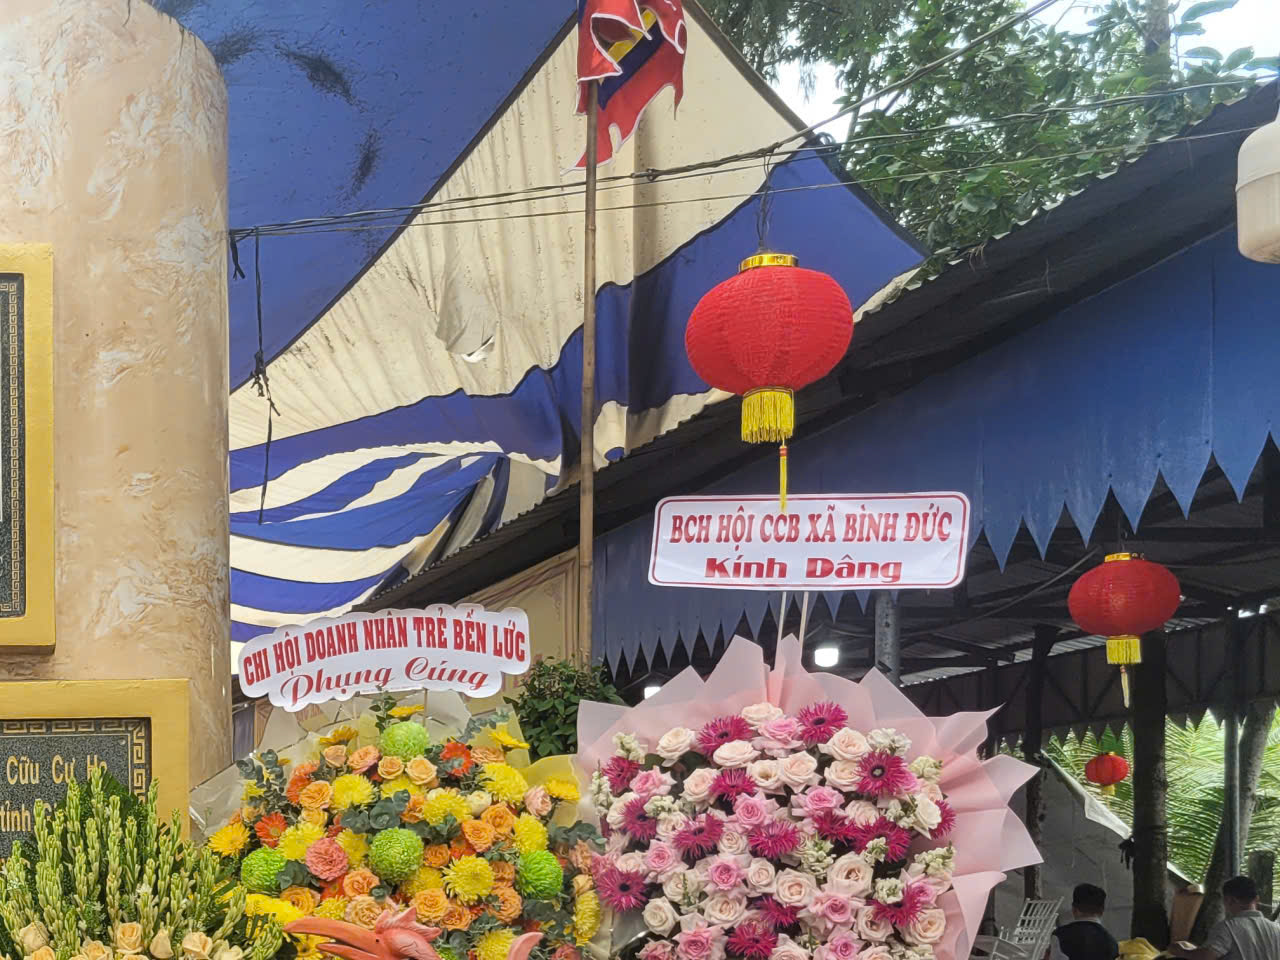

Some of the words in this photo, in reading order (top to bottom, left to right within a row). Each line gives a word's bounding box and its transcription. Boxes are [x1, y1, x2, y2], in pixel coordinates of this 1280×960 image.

[669, 514, 712, 543] BCH
[716, 506, 755, 551] HỘI
[760, 513, 800, 543] CCB
[805, 504, 837, 543] XÃ
[843, 504, 899, 542] BÌNH
[903, 503, 952, 542] ĐỨC
[704, 554, 787, 579] Kính
[805, 554, 902, 584] Dâng
[243, 648, 271, 686] CHI
[273, 632, 301, 676] HỘI
[304, 622, 359, 664] DOANH
[363, 612, 408, 650] NHÂN
[413, 607, 448, 649] TRẺ
[453, 610, 486, 653] BẾN
[493, 619, 526, 662] LỨC
[280, 668, 396, 705] Phụng
[405, 656, 490, 691] Cúng
[52, 754, 76, 784] Cư
[0, 800, 32, 832] tỉnh
